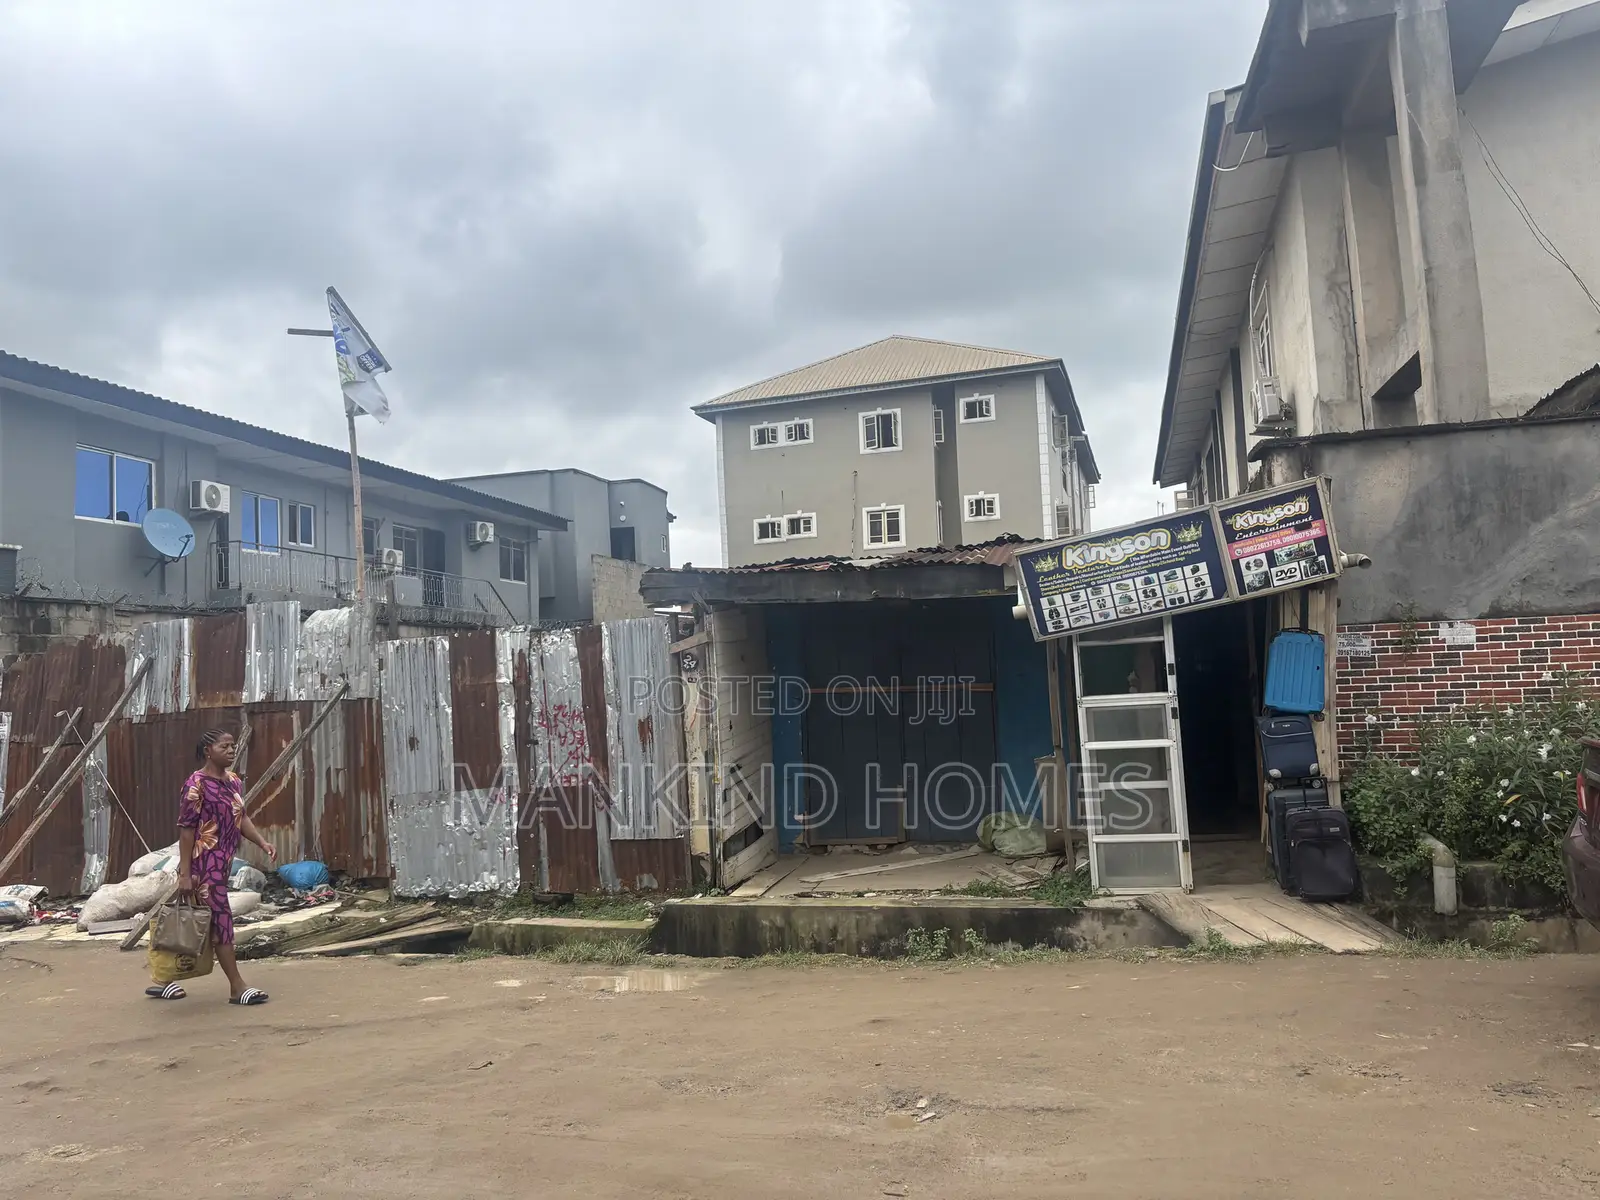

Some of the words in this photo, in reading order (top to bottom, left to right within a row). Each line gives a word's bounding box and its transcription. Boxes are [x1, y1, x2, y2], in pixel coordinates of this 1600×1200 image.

[1234, 501, 1308, 529] Kingson
[1235, 515, 1313, 540] Entertainment
[1063, 529, 1170, 568] Kingson
[1037, 573, 1070, 584] Leather
[1073, 564, 1109, 575] Ventures
[1275, 567, 1297, 578] DVD
